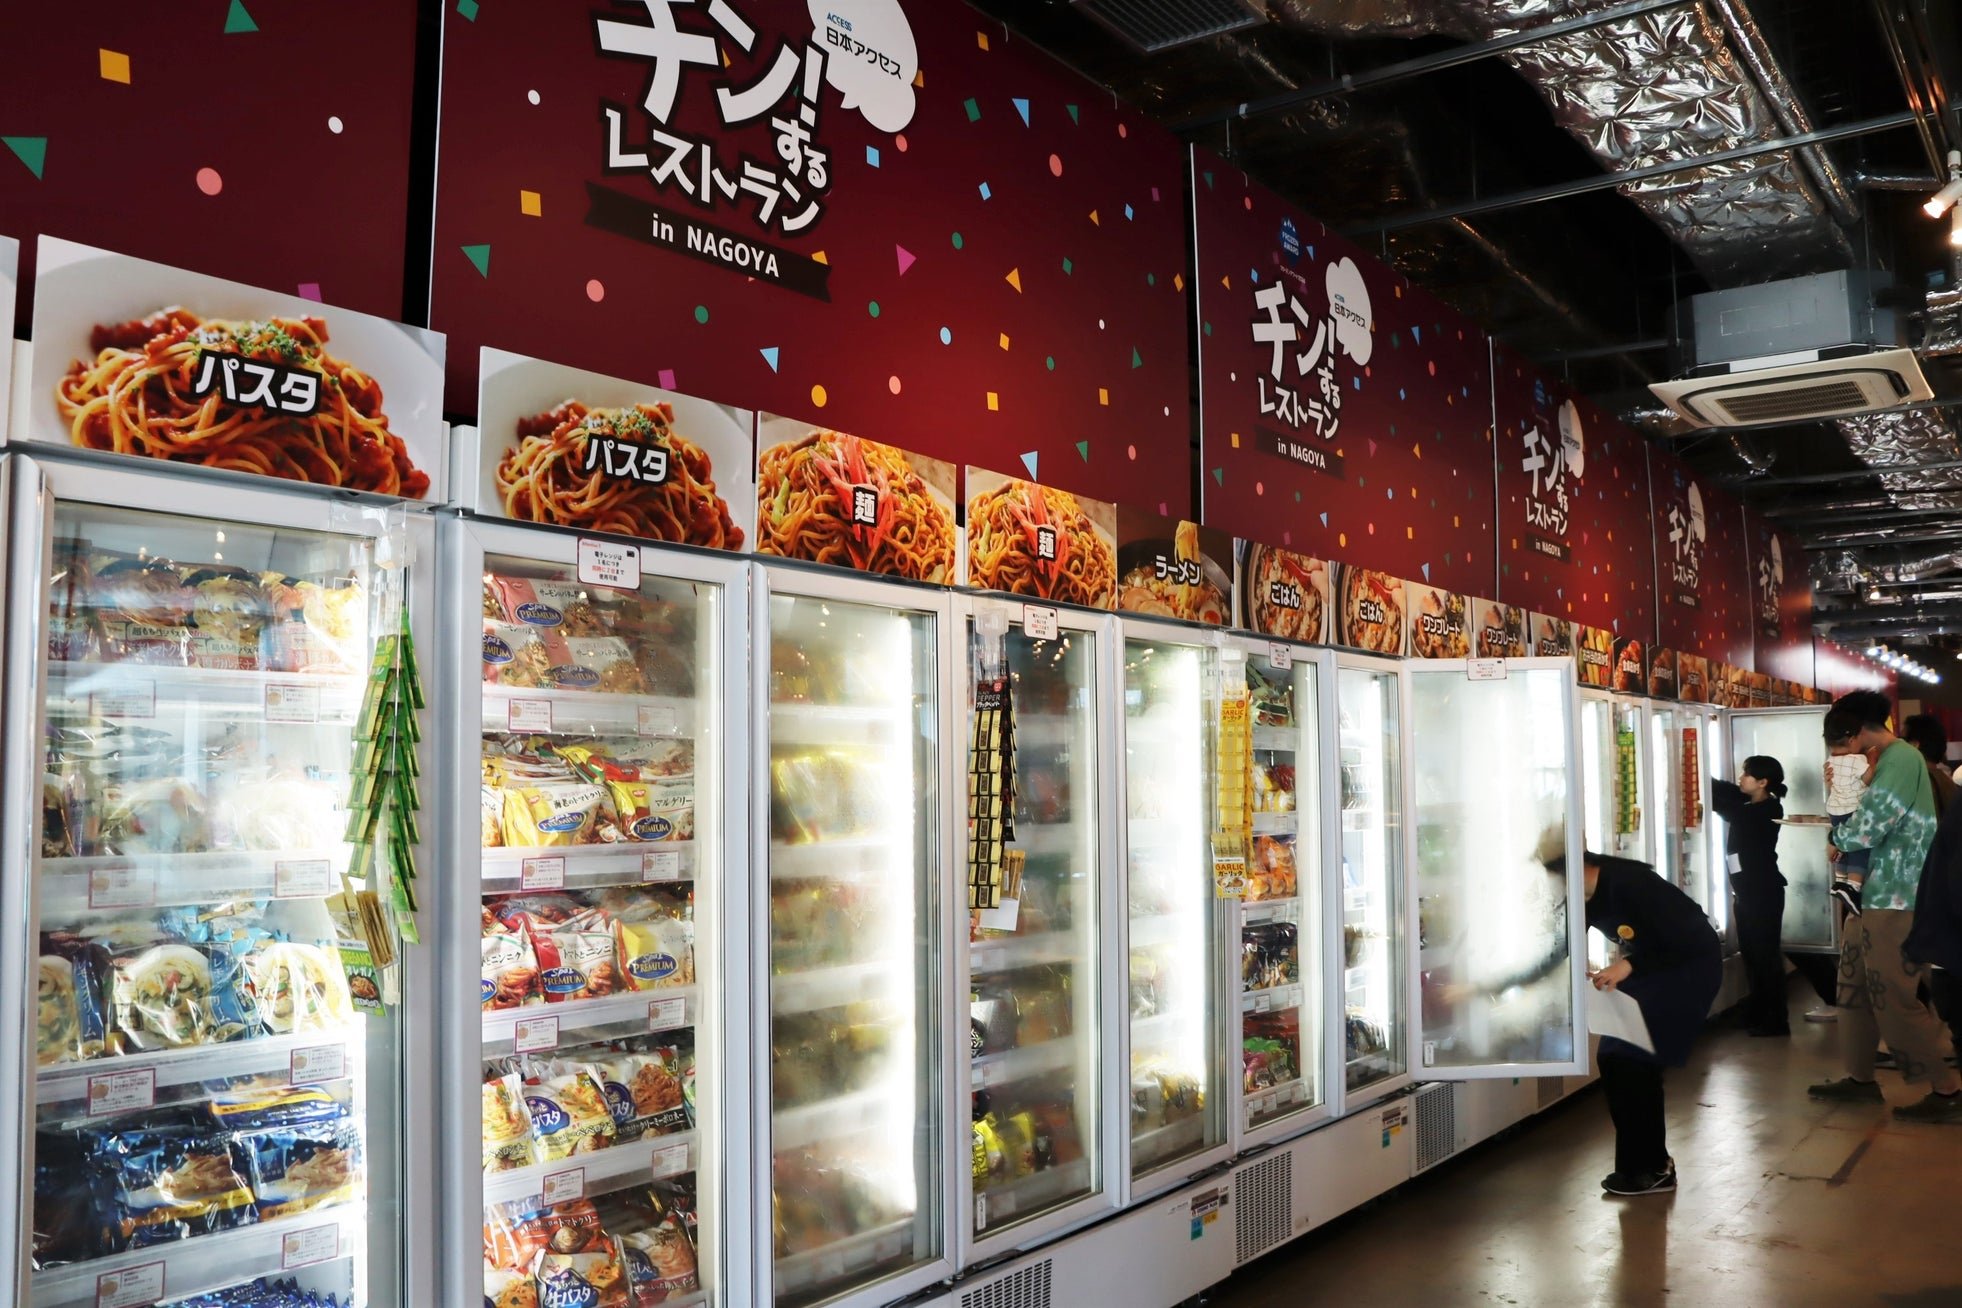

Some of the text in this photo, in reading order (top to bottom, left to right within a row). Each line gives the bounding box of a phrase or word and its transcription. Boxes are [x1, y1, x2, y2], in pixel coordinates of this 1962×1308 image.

[827, 12, 852, 32] ACCESS
[826, 26, 901, 80] 日本アクセス
[771, 115, 828, 189] する
[606, 107, 820, 232] レストラン
[652, 212, 779, 278] in NAGOYA
[1334, 302, 1366, 328] 日本アクセス
[196, 354, 318, 414] パスタ
[1317, 366, 1341, 409] する
[1258, 377, 1339, 440] レストラン
[586, 437, 667, 483] パスタ
[1277, 438, 1325, 470] in NAGOYA
[855, 487, 876, 524] 麺
[1526, 497, 1568, 536] レストラン
[1039, 527, 1055, 559] 麺
[1155, 555, 1201, 585] ラーメン
[1271, 583, 1300, 609] ごはん
[519, 609, 560, 620] PREMIUM
[1359, 600, 1384, 625] ごはん
[1423, 614, 1461, 637] ワンプレート
[1486, 628, 1519, 646] ワンプレート
[542, 813, 583, 829] PREMIUM
[636, 823, 669, 833] PREMIUM
[543, 975, 584, 985] PREMIUM
[632, 961, 674, 973] PREMIUM
